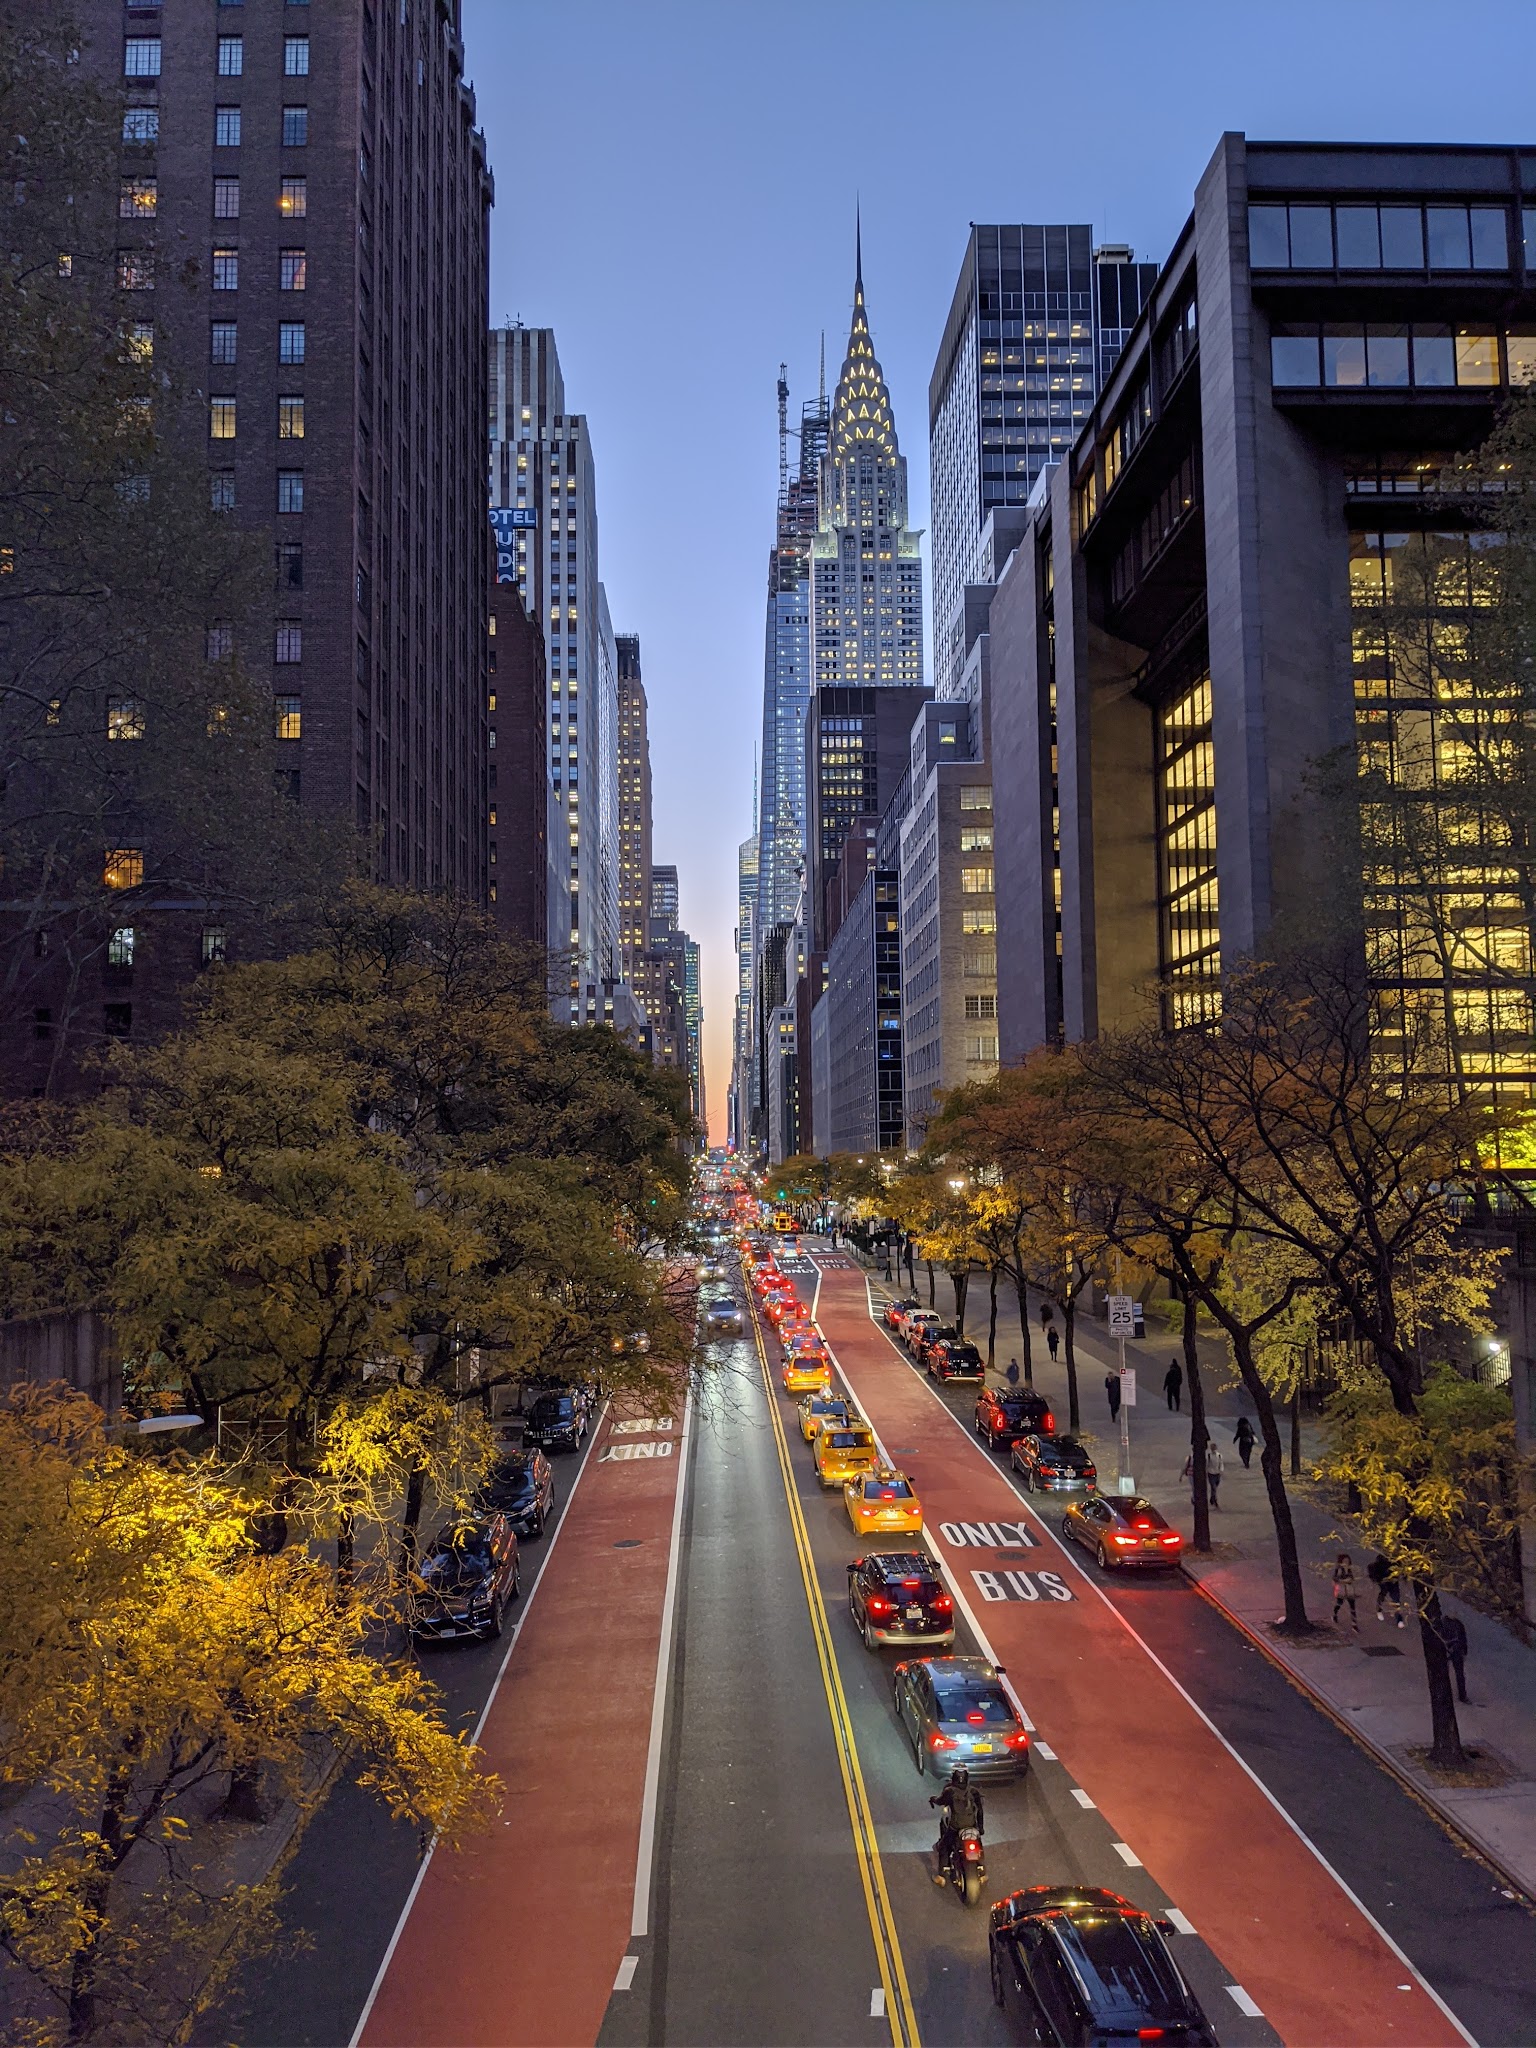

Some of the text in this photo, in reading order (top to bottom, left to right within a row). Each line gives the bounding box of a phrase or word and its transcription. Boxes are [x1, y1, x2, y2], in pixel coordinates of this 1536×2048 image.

[1112, 1312, 1131, 1323] 25
[597, 1442, 673, 1463] ONLY
[939, 1522, 1034, 1547] ONLY
[970, 1570, 1073, 1602] BUS
